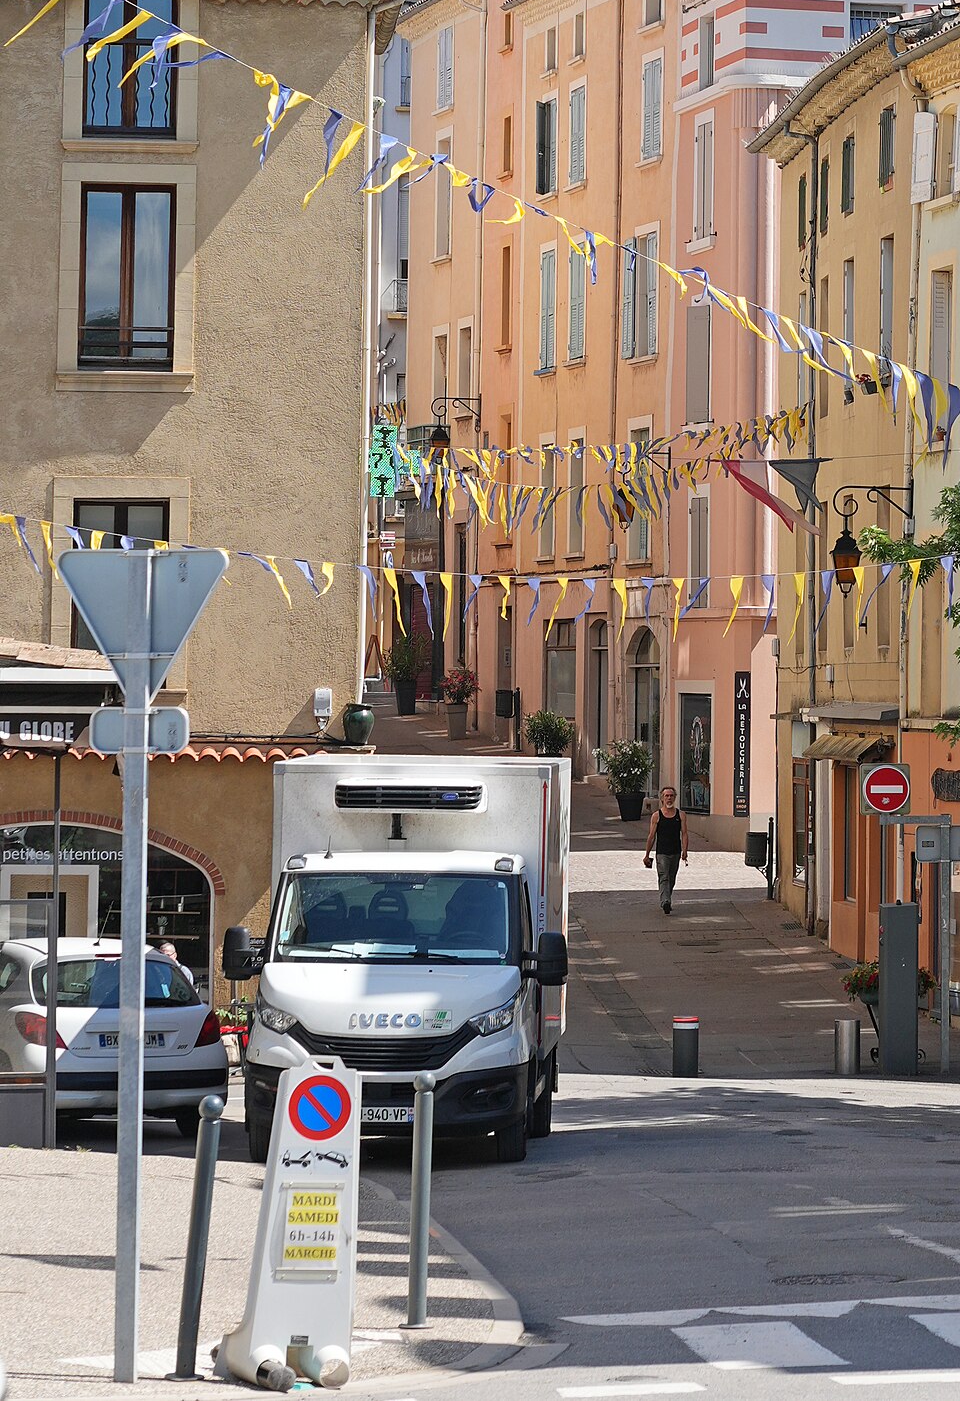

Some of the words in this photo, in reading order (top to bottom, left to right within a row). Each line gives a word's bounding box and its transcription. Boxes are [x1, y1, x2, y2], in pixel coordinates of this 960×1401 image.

[20, 721, 75, 743] GLOBE
[2, 848, 50, 862] petites
[349, 1013, 421, 1030] IVECO
[361, 1108, 407, 1121] -940-VP
[292, 1195, 337, 1207] MARDI
[288, 1211, 339, 1223] SAMEDI
[284, 1248, 337, 1259] MARCHE
